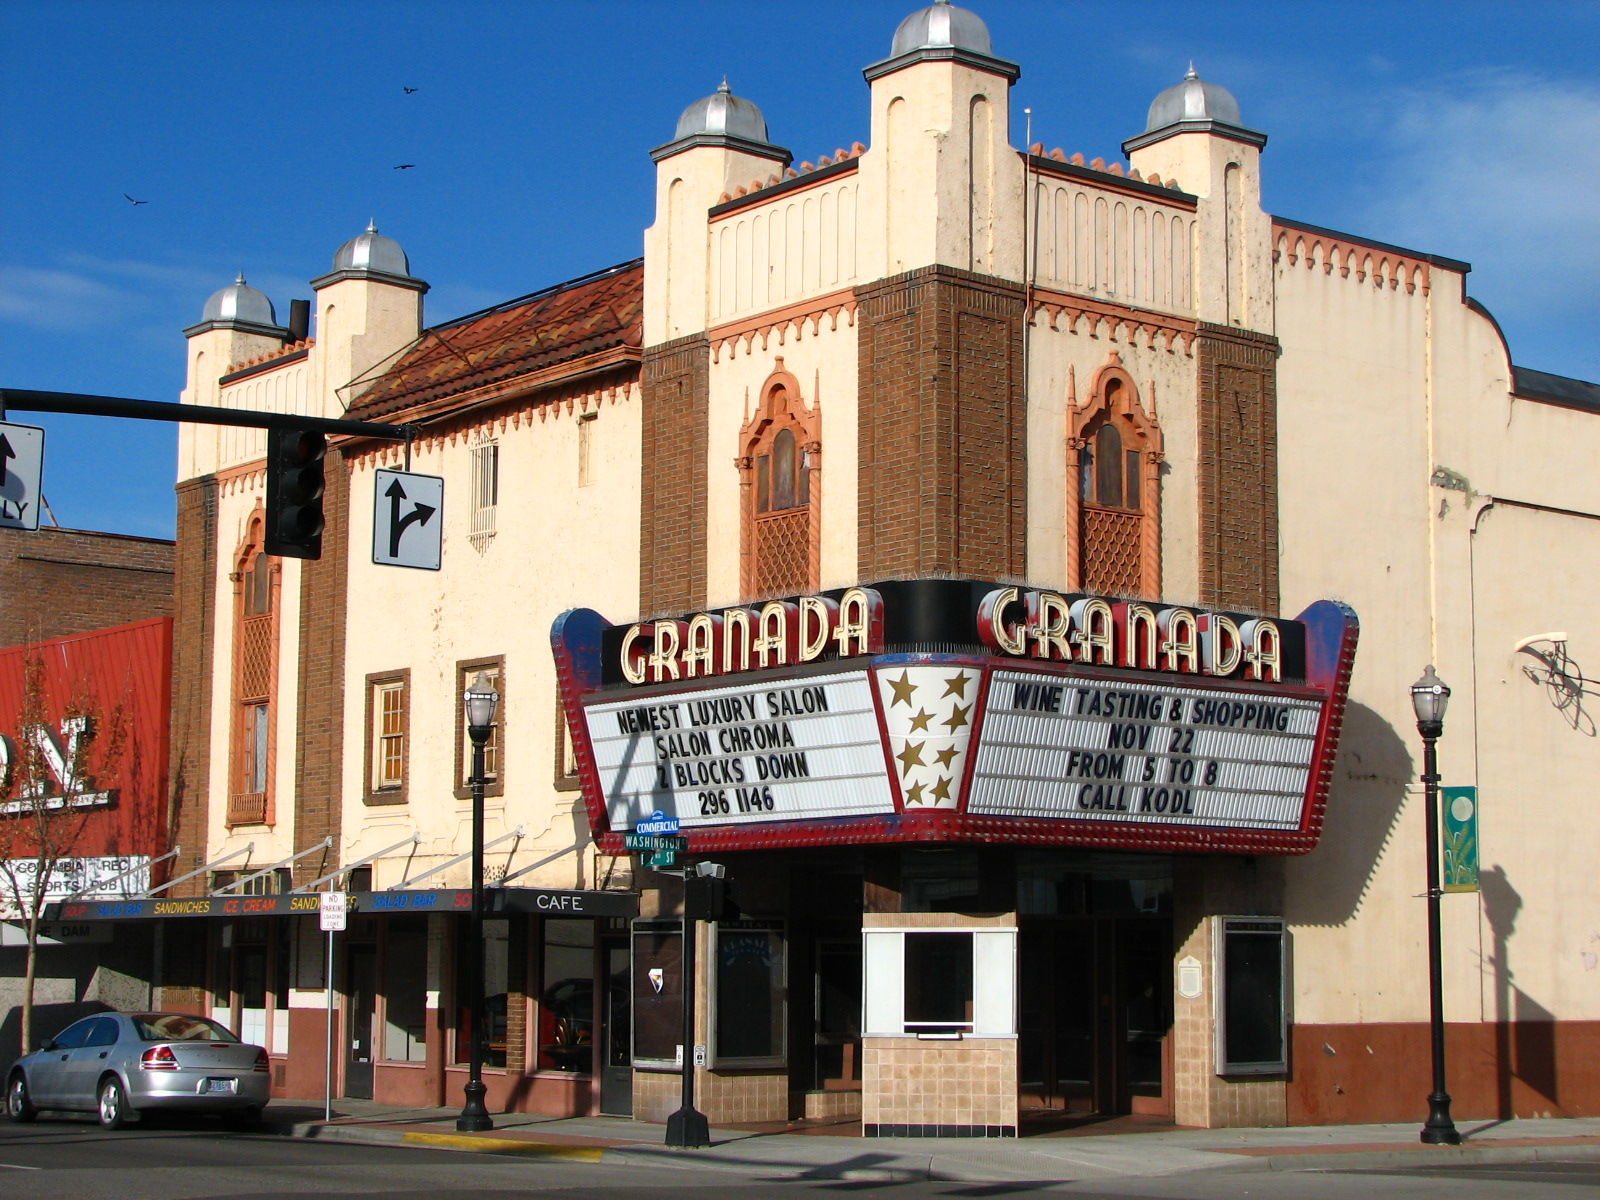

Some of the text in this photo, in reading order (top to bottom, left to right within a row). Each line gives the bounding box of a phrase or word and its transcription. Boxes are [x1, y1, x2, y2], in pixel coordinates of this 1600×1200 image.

[620, 587, 869, 684] GRANADA
[977, 587, 1281, 683] GRANADA
[617, 686, 829, 734] NEWEST LUXURY SALON
[1013, 683, 1288, 731] WINE TASTING & SHOPPING
[656, 722, 795, 760] SALON CHROMA
[1108, 723, 1195, 754] NOV 22
[0, 717, 86, 797] N
[658, 751, 809, 789] 2 BLOCKS DOWN
[1066, 750, 1218, 785] FROM 5 TO 8
[698, 785, 775, 816] 296 1146
[1078, 784, 1194, 814] CALL KODL
[637, 820, 678, 833] COMMERCIAL
[625, 836, 680, 849] WASHINGTON
[666, 851, 674, 863] ST
[27, 881, 80, 892] SORTS
[328, 895, 338, 903] NO
[153, 901, 210, 915] SANDWICHES
[223, 900, 239, 913] ICE
[242, 899, 278, 912] CREAM
[372, 894, 409, 909] SALAD
[413, 892, 438, 908] BAR
[536, 894, 584, 911] CAFE
